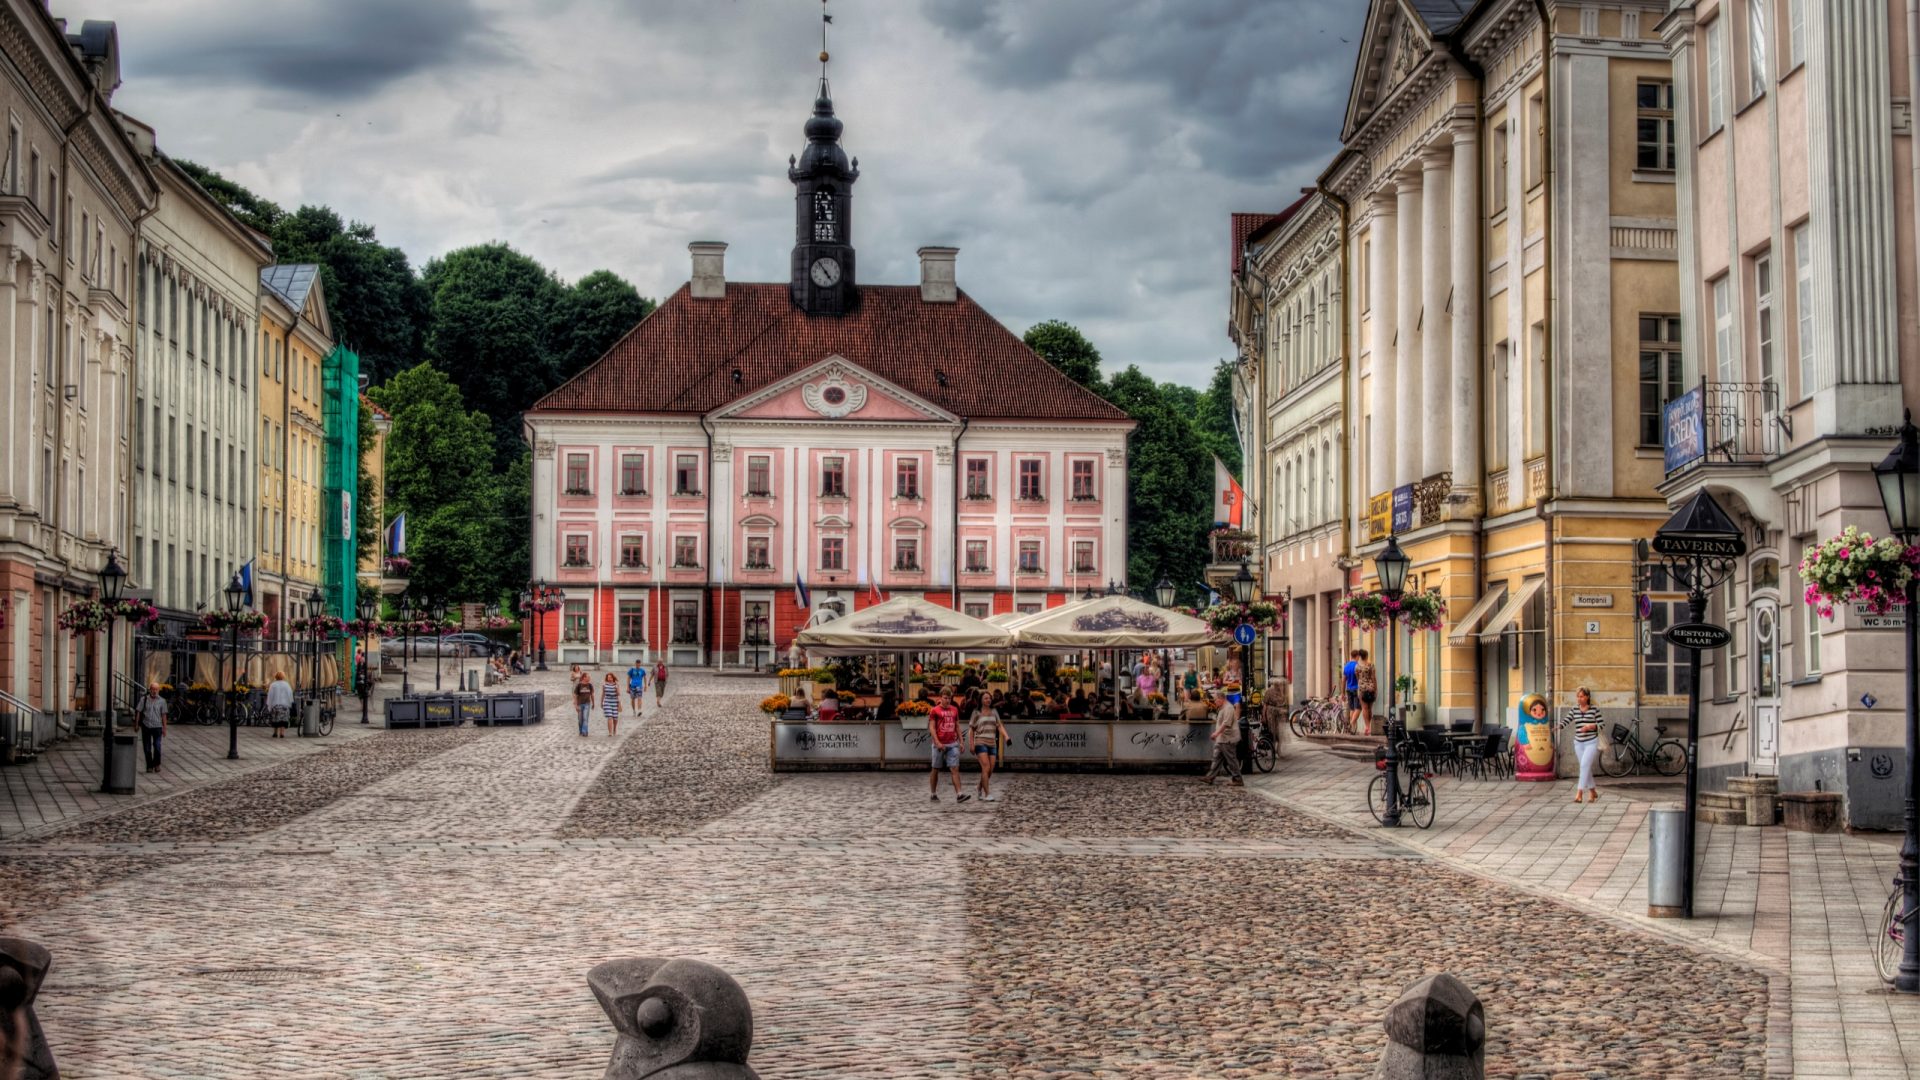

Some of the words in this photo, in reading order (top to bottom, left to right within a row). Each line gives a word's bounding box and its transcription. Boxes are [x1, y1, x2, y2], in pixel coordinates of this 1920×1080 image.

[1661, 539, 1738, 553] TAVERNA
[1857, 604, 1900, 613] MARI
[1863, 618, 1880, 626] WC
[1590, 623, 1596, 632] 2
[1673, 629, 1725, 638] RESTORAN
[1686, 637, 1712, 645] BAAR
[1045, 732, 1087, 740] BACARDI
[1045, 741, 1087, 749] OGETHER
